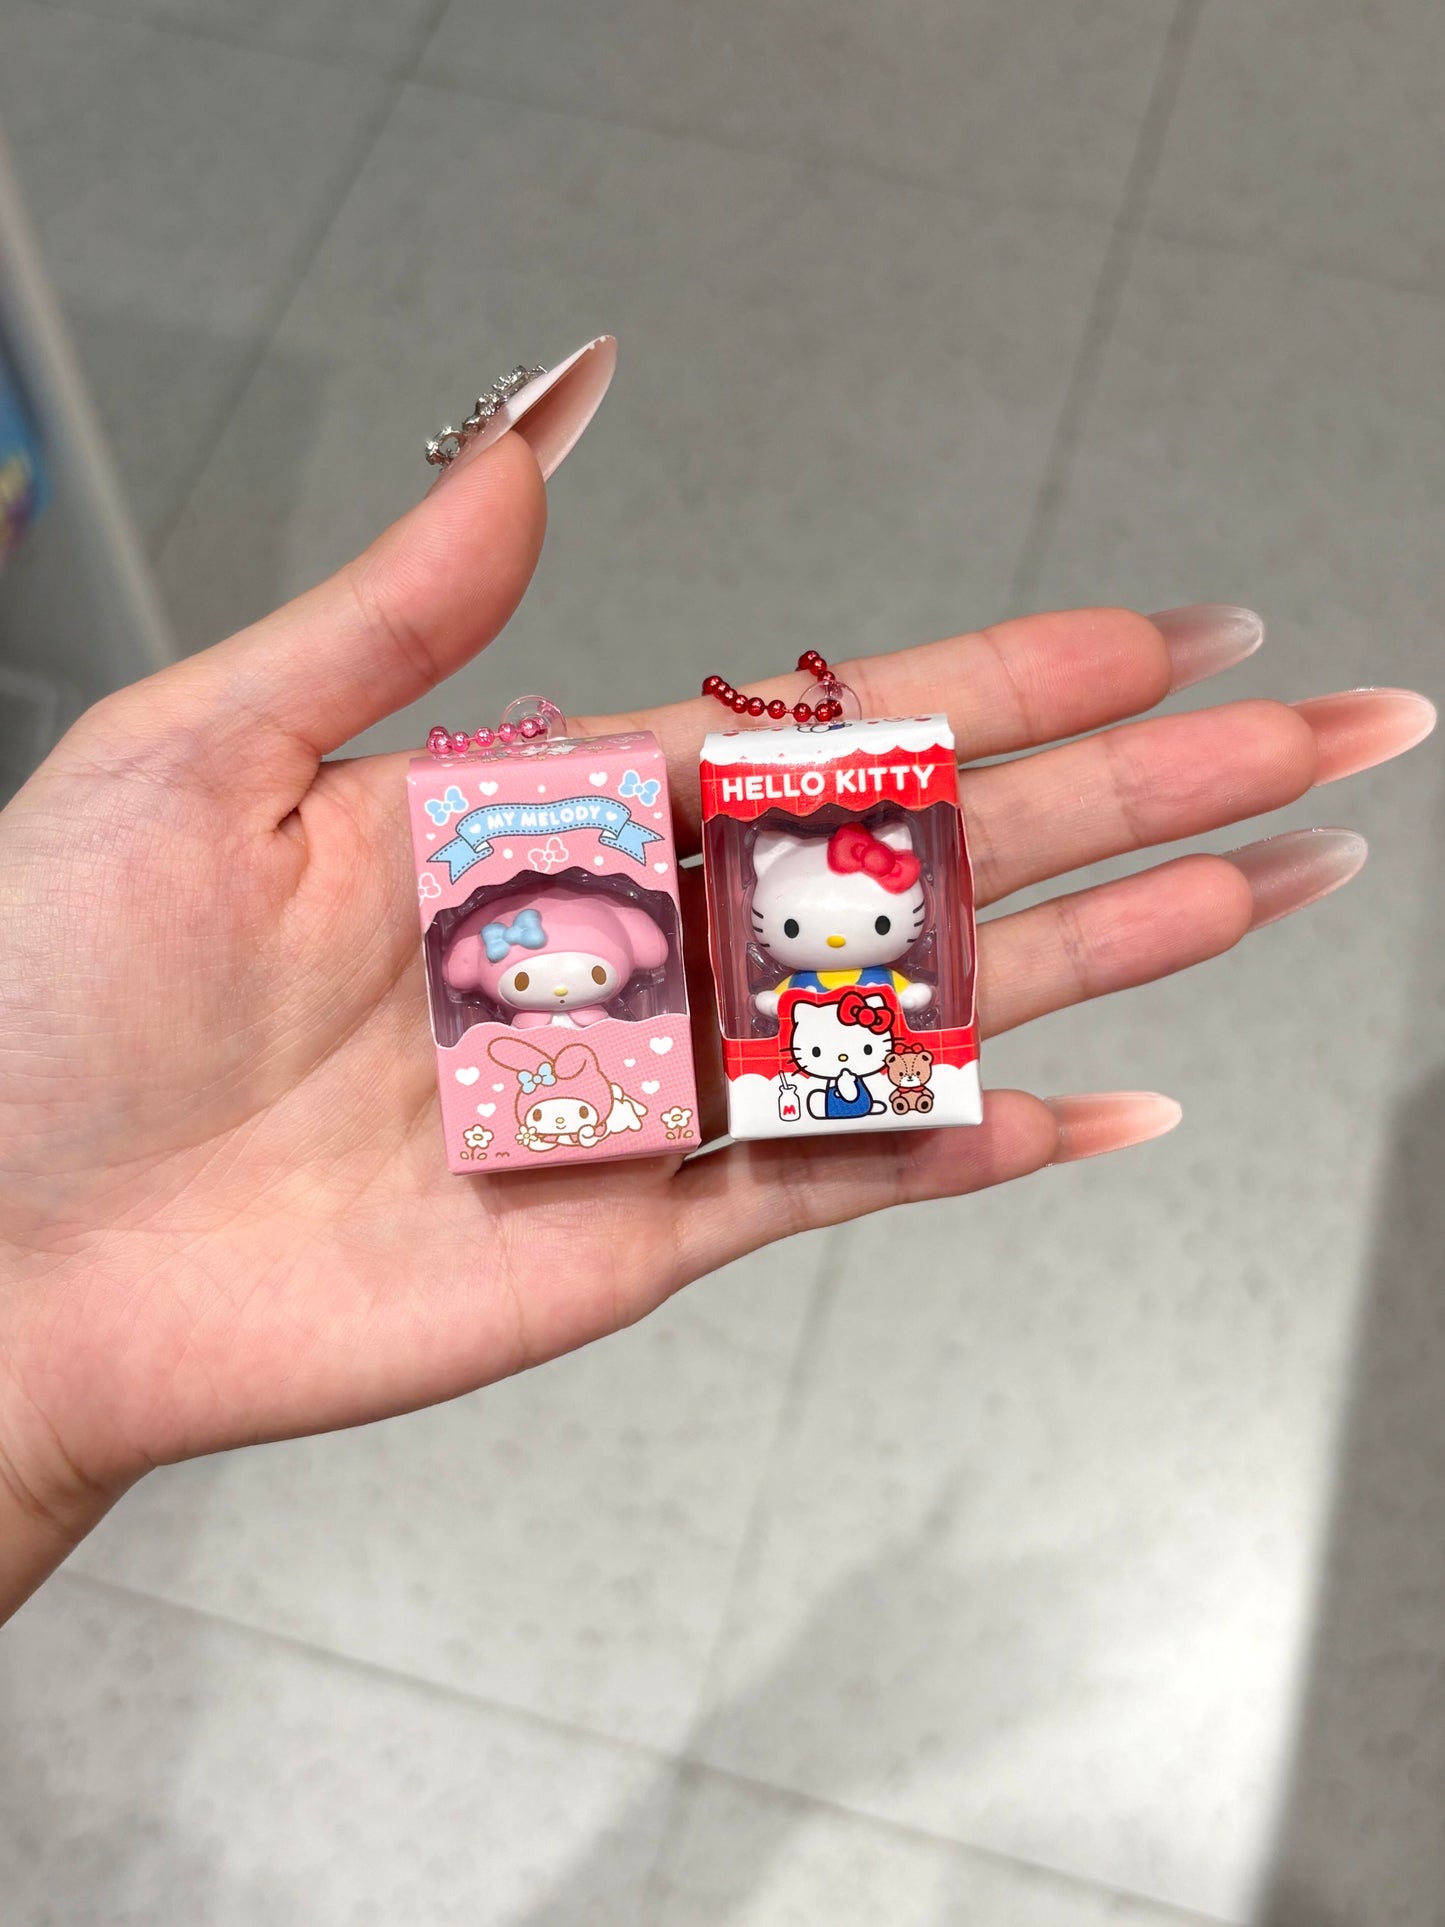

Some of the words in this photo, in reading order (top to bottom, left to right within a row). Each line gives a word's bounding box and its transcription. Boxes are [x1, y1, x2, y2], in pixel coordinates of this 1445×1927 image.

[721, 771, 826, 802] HELLO
[835, 764, 935, 795] KITTY
[486, 811, 516, 830] MY
[520, 805, 602, 827] MELODY
[783, 1104, 796, 1115] M
